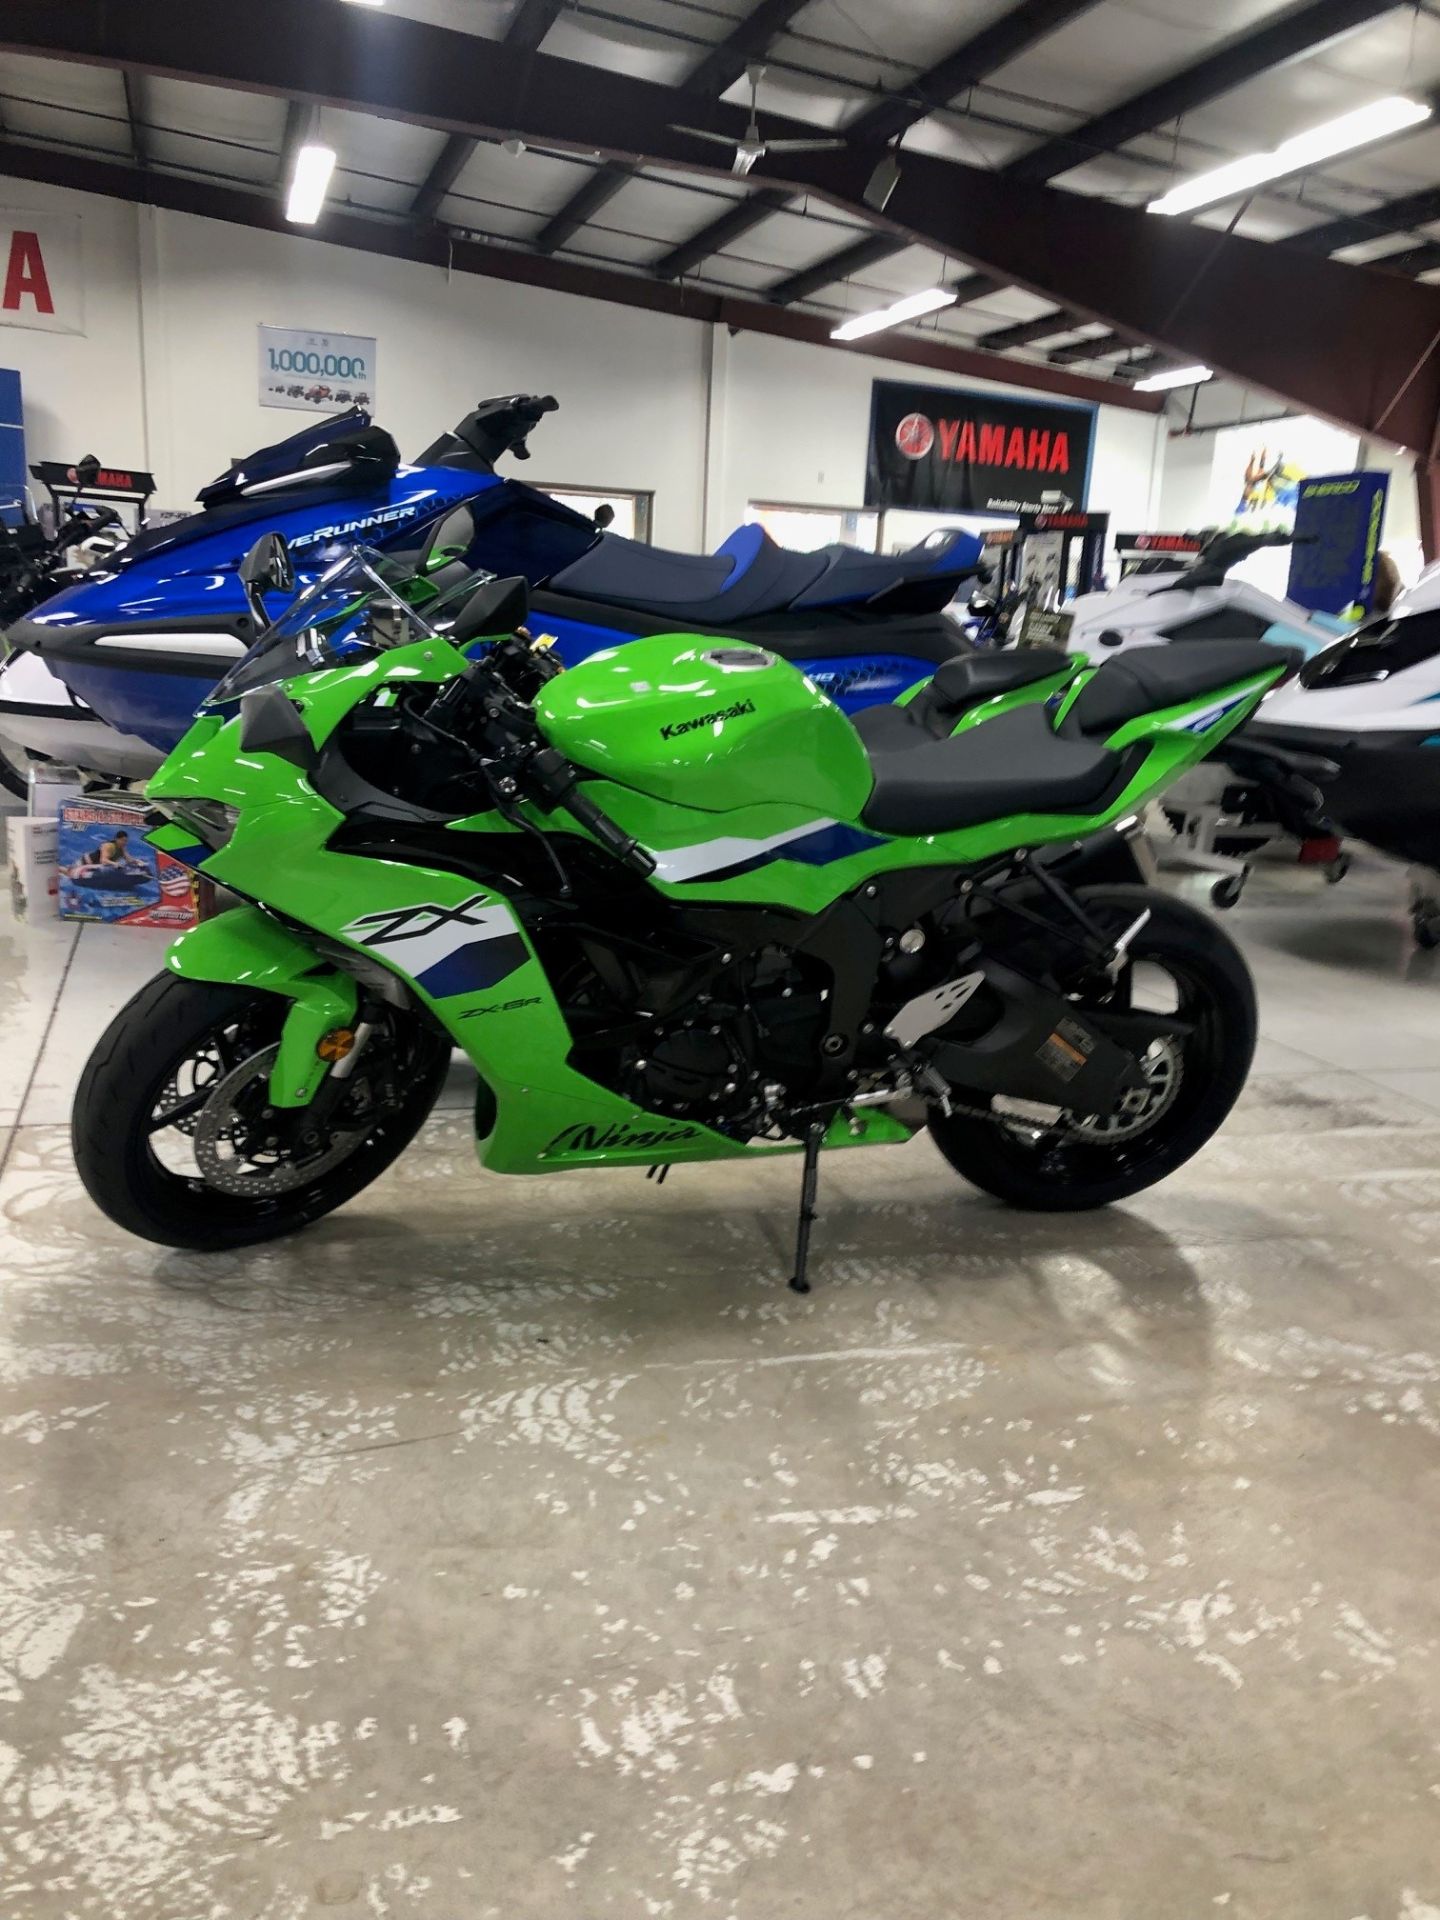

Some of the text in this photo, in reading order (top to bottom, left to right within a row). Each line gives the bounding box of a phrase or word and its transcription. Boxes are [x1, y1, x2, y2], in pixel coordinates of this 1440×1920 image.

[2, 231, 54, 314] A
[938, 418, 1070, 475] YAMAHA
[97, 470, 133, 489] MAHA
[659, 698, 757, 741] Kawasaki
[352, 893, 491, 947] ZX
[457, 996, 544, 1020] ZX-6R
[544, 1122, 703, 1154] Ninja
